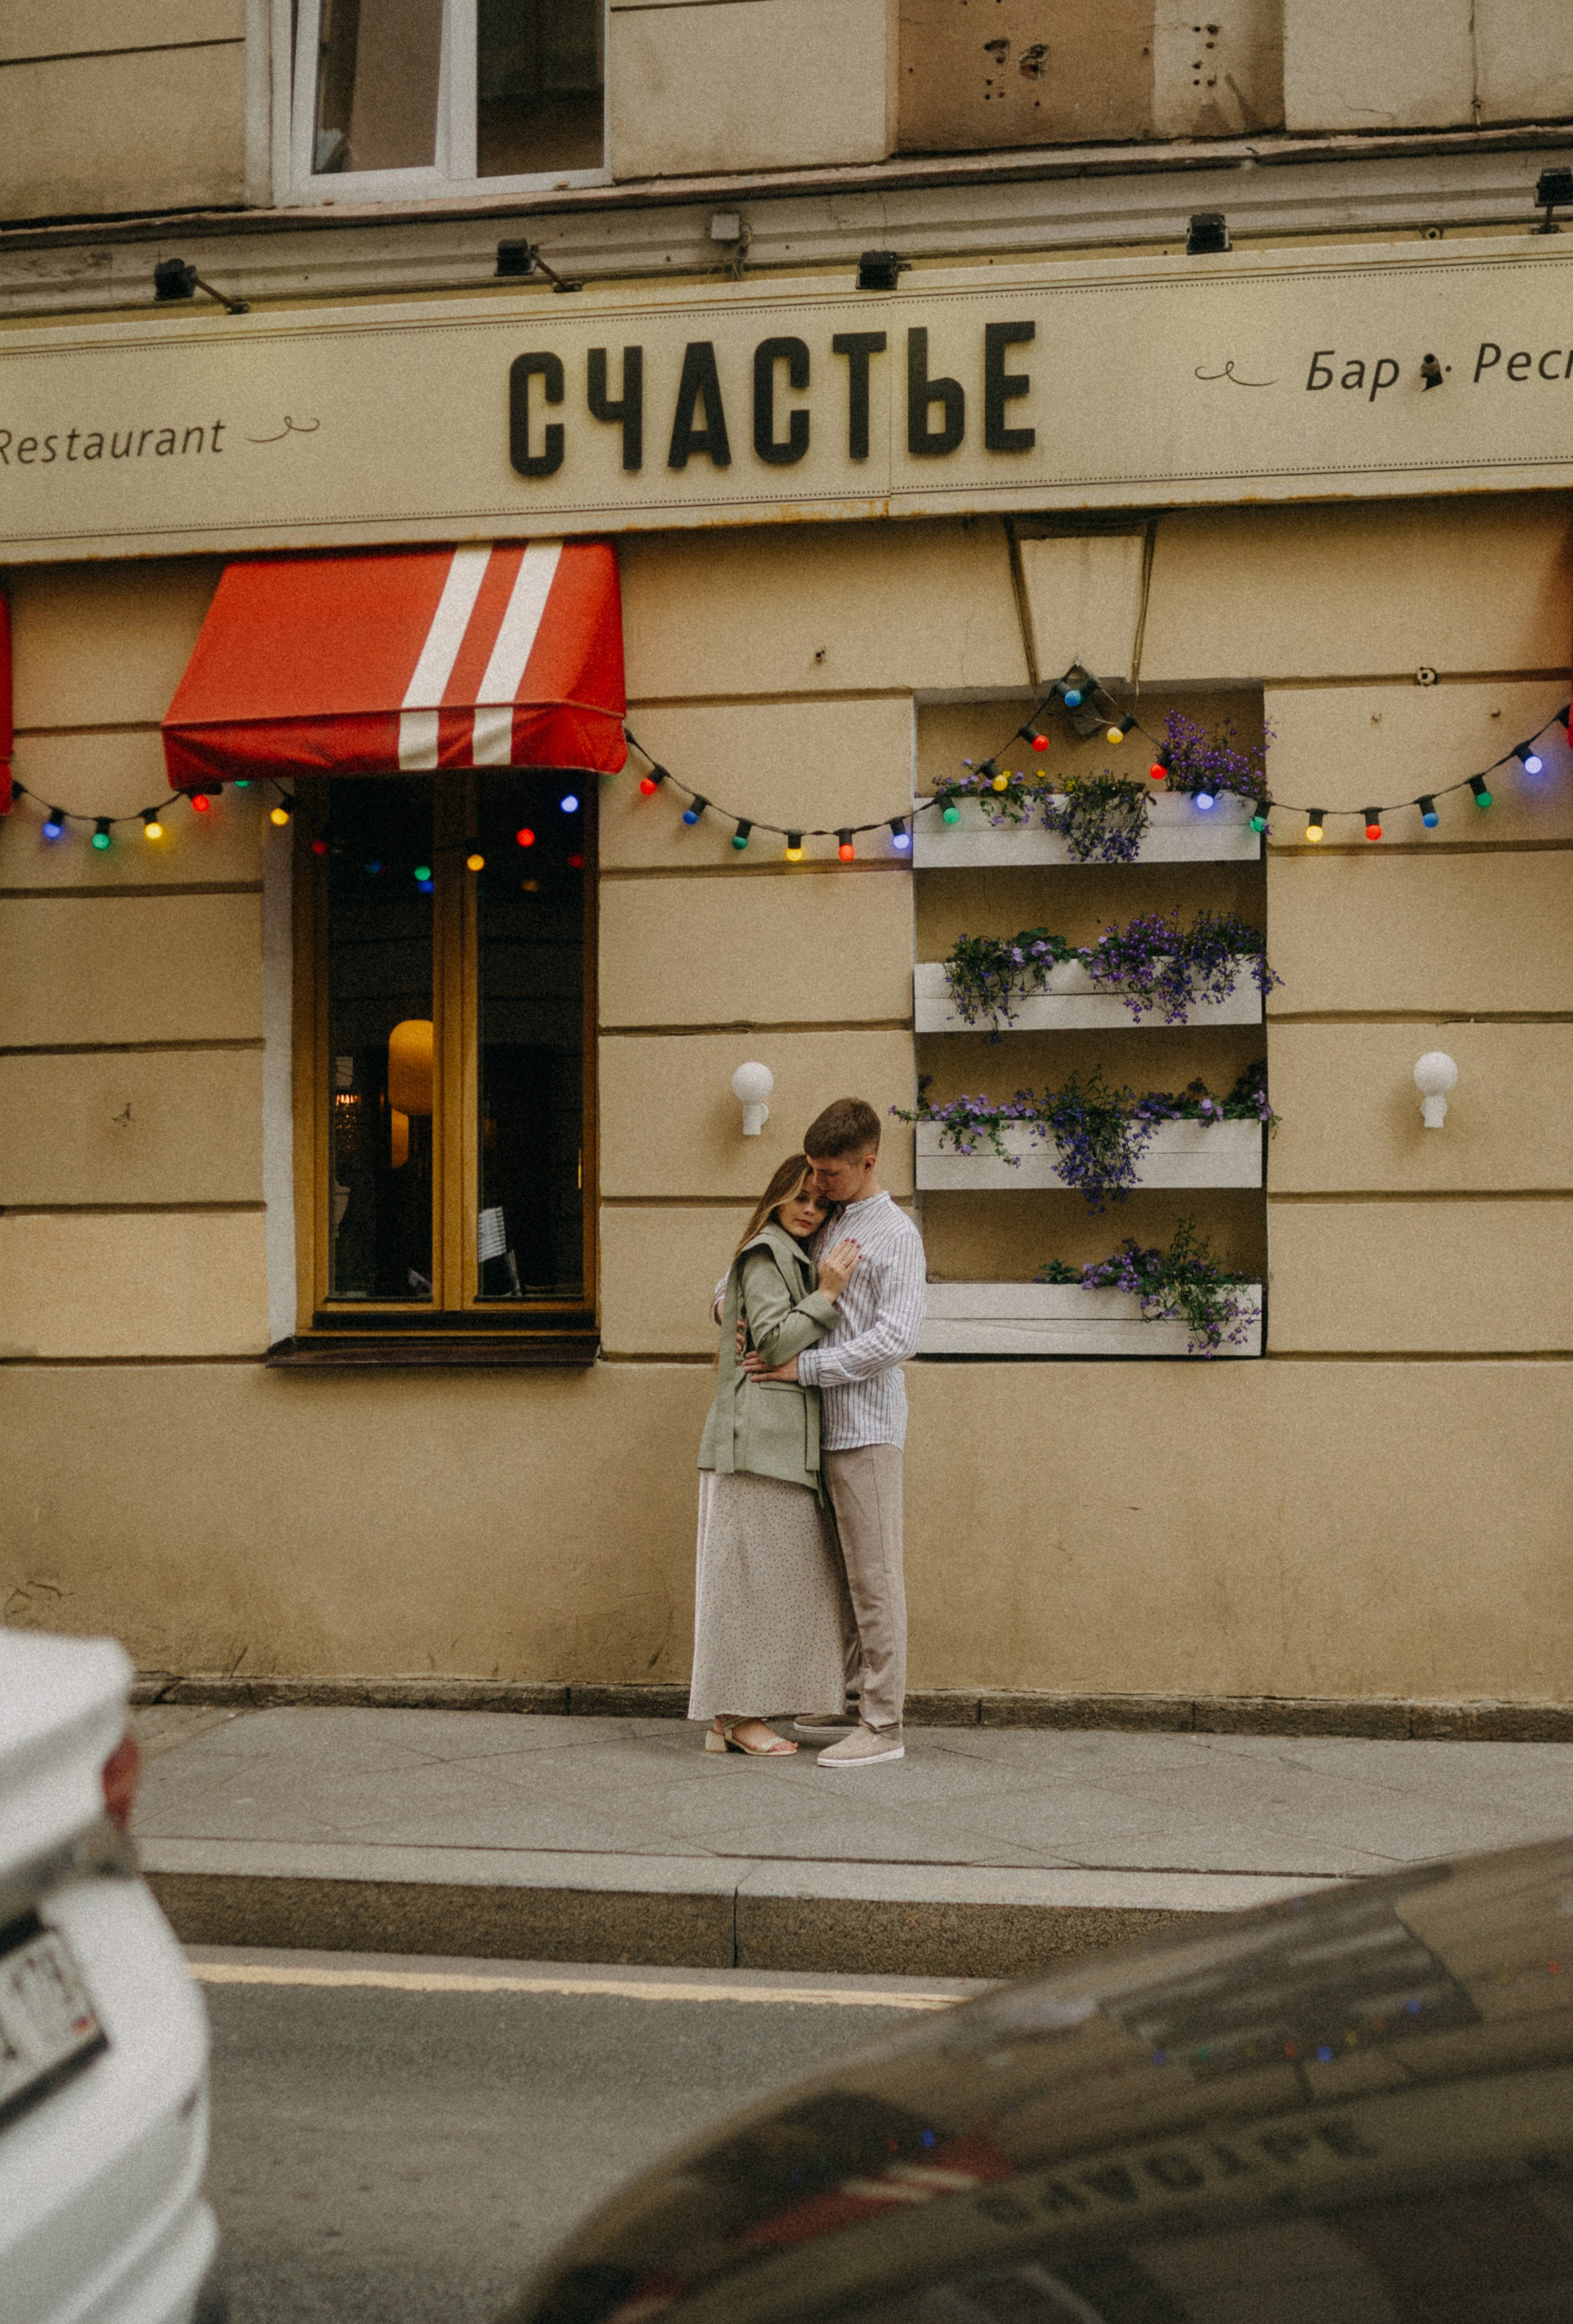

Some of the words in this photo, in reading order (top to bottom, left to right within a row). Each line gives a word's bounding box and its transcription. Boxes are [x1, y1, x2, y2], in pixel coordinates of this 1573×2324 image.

[509, 320, 1036, 477] СЧАСТЬЕ
[1306, 350, 1400, 402] Бар
[1472, 342, 1573, 383] Рес
[0, 419, 226, 465] Restaurant
